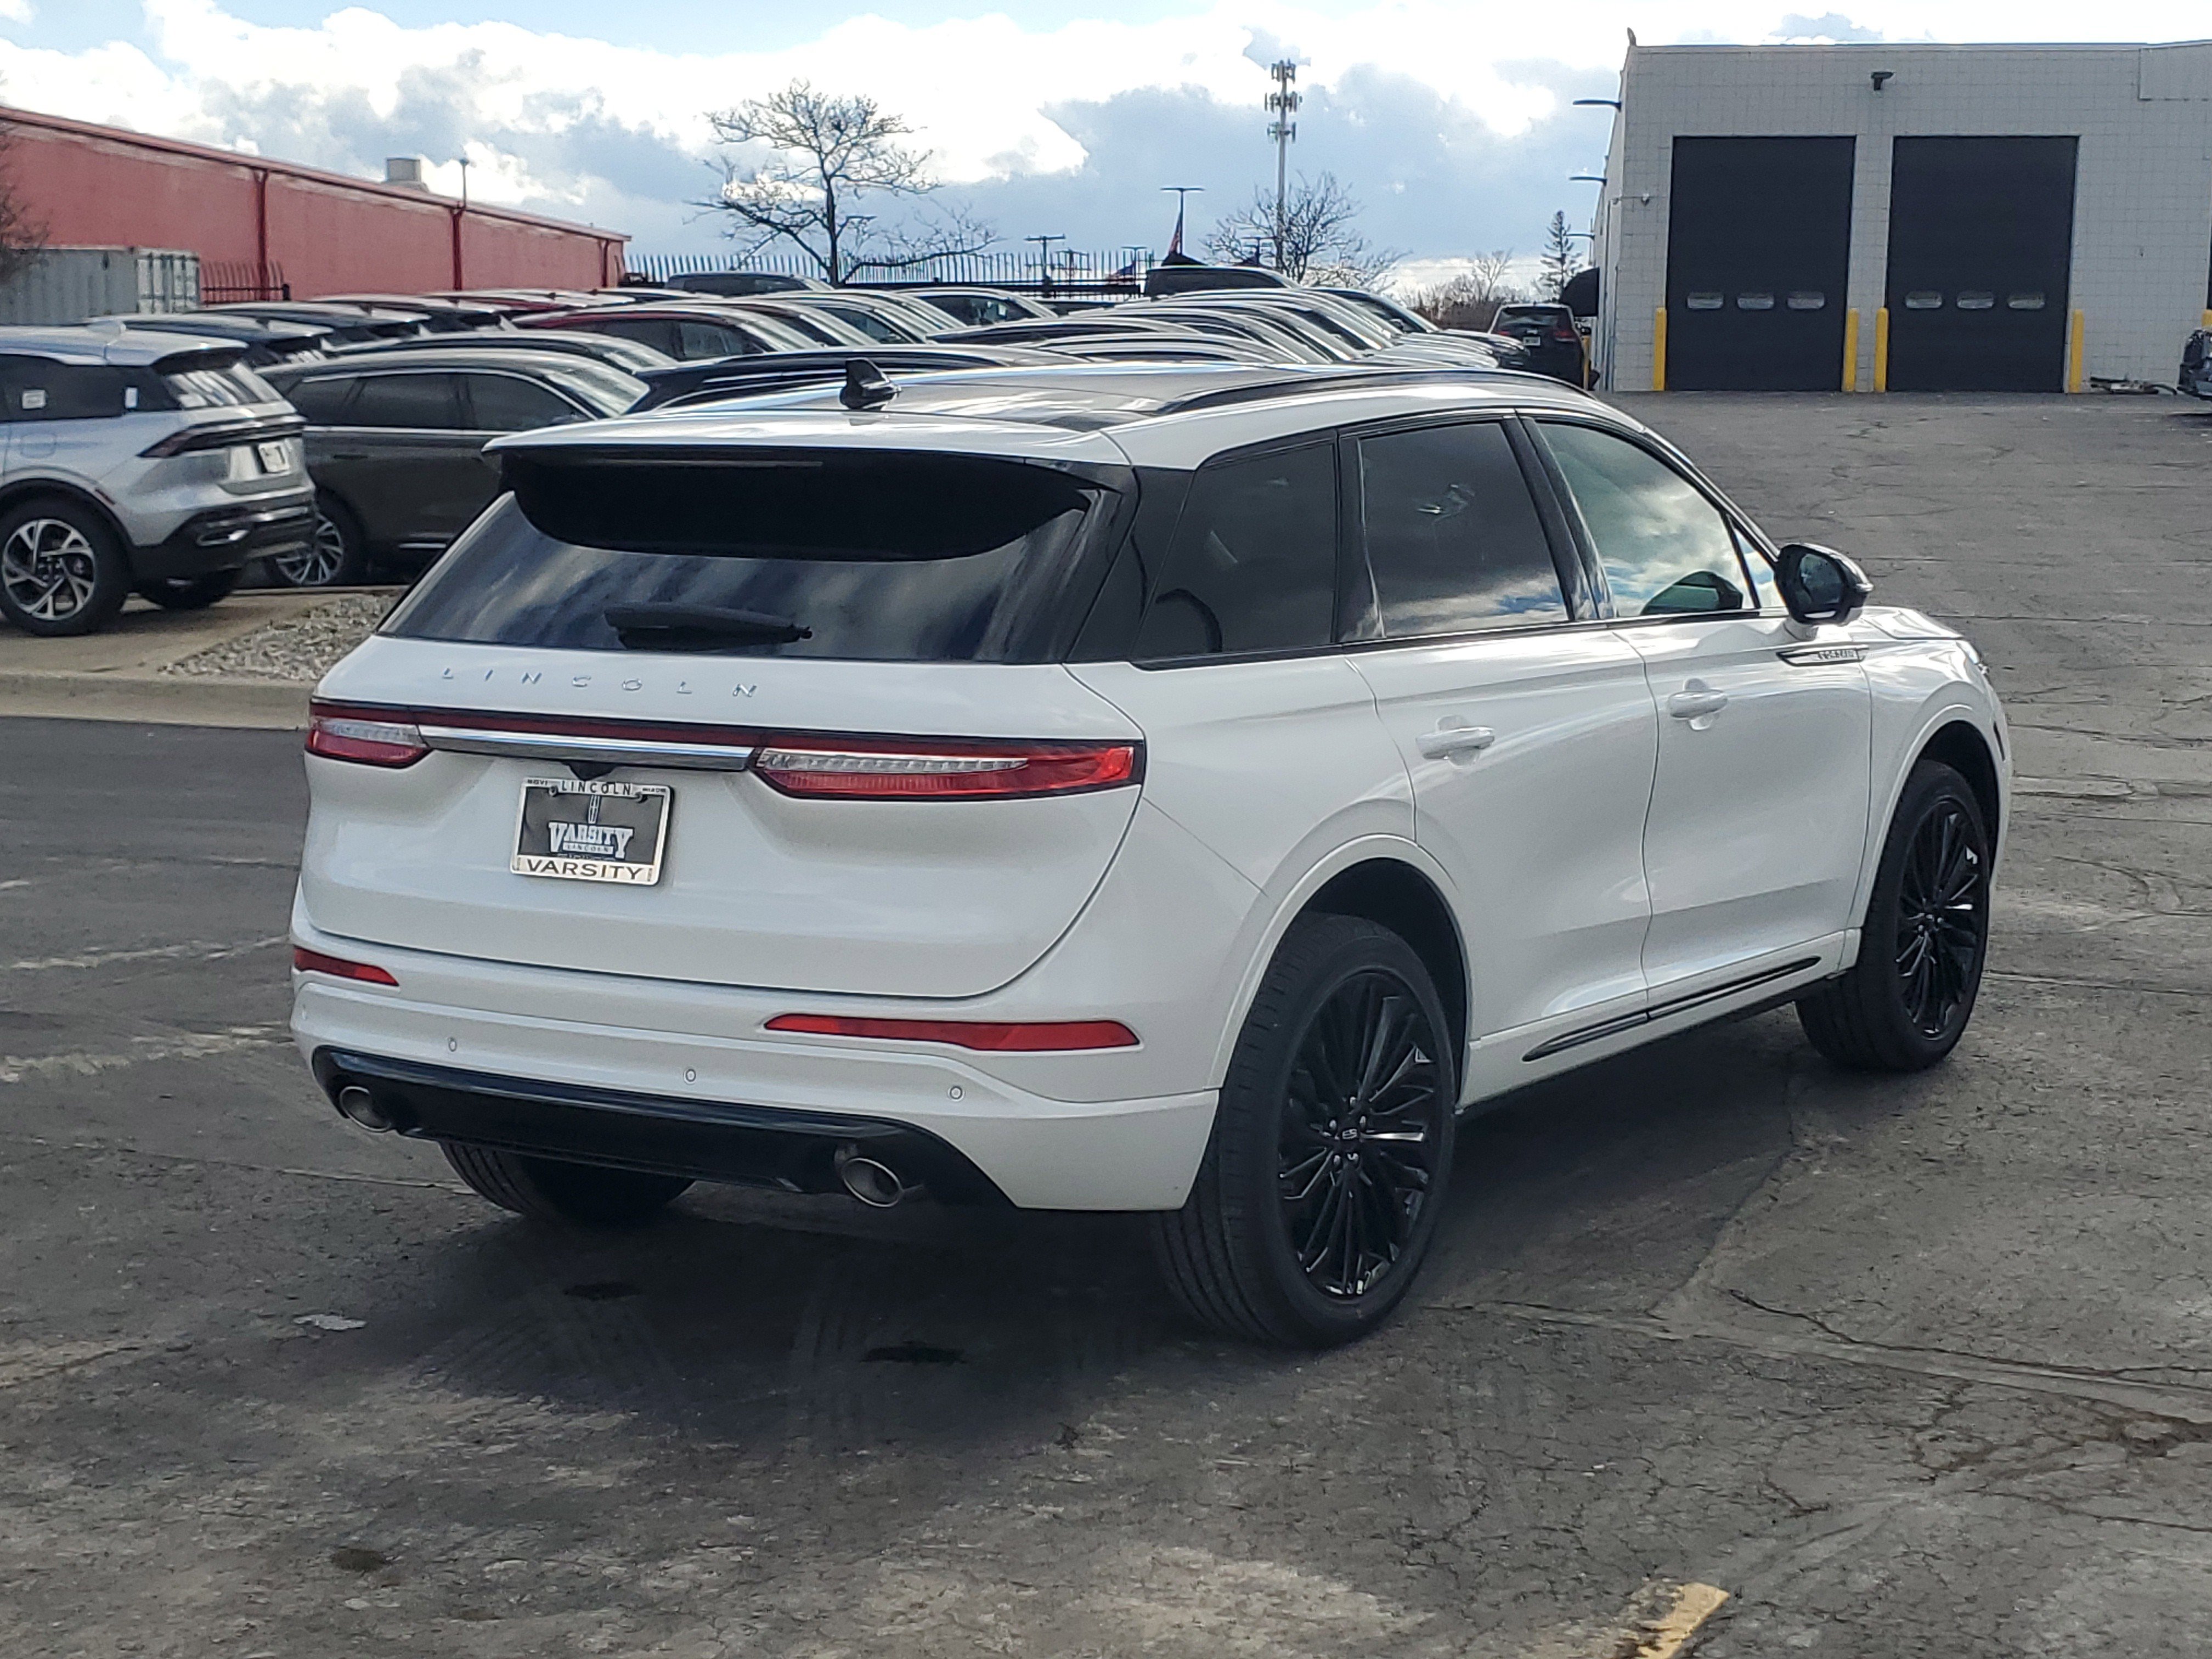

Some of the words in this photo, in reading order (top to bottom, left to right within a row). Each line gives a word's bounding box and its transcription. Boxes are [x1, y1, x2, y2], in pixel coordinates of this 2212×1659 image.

[441, 667, 757, 698] LINCOLN
[561, 780, 631, 795] LINCOLN
[549, 822, 634, 859] VARSITY
[527, 859, 643, 880] VARSITY
